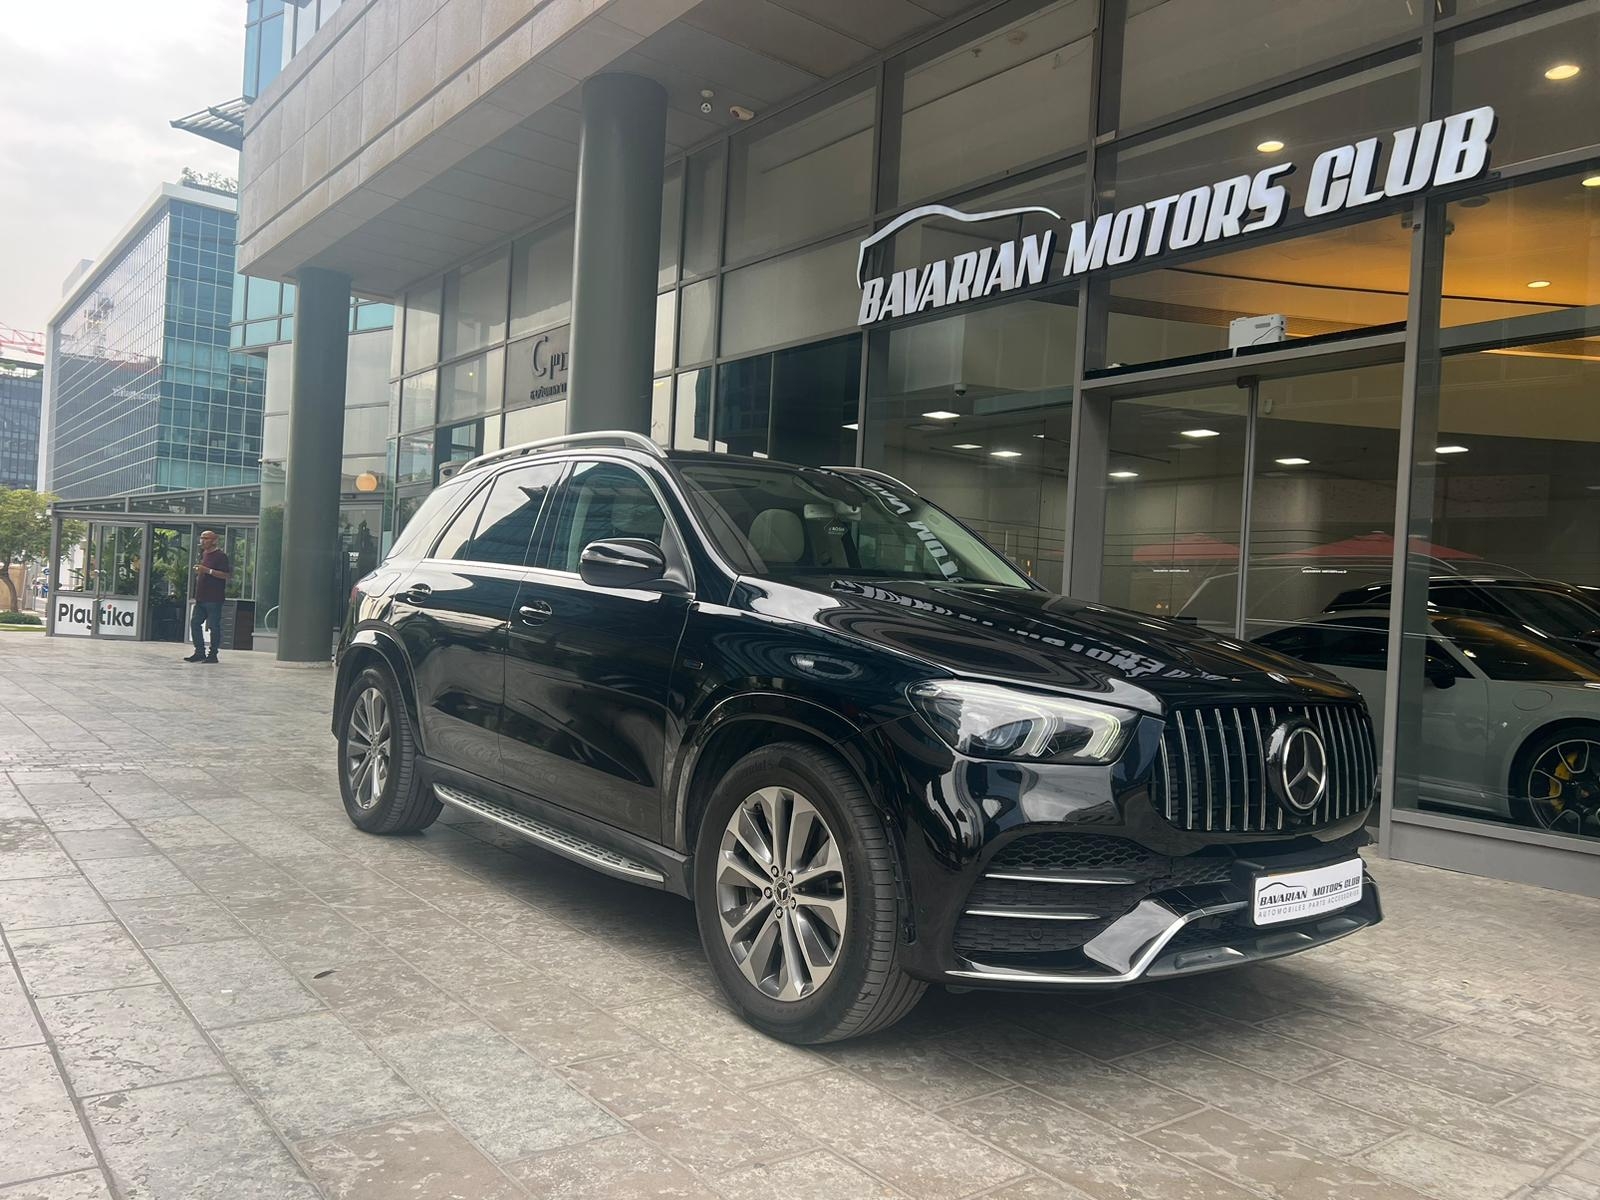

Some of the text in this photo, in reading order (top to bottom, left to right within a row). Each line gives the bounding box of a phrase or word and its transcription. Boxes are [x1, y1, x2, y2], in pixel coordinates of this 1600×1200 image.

[857, 106, 1496, 326] BAVARIAN MOTORS CLUB
[1260, 876, 1360, 906] BAVARIAN MOTORS CLUB
[1258, 904, 1306, 918] AUTOMOBILES
